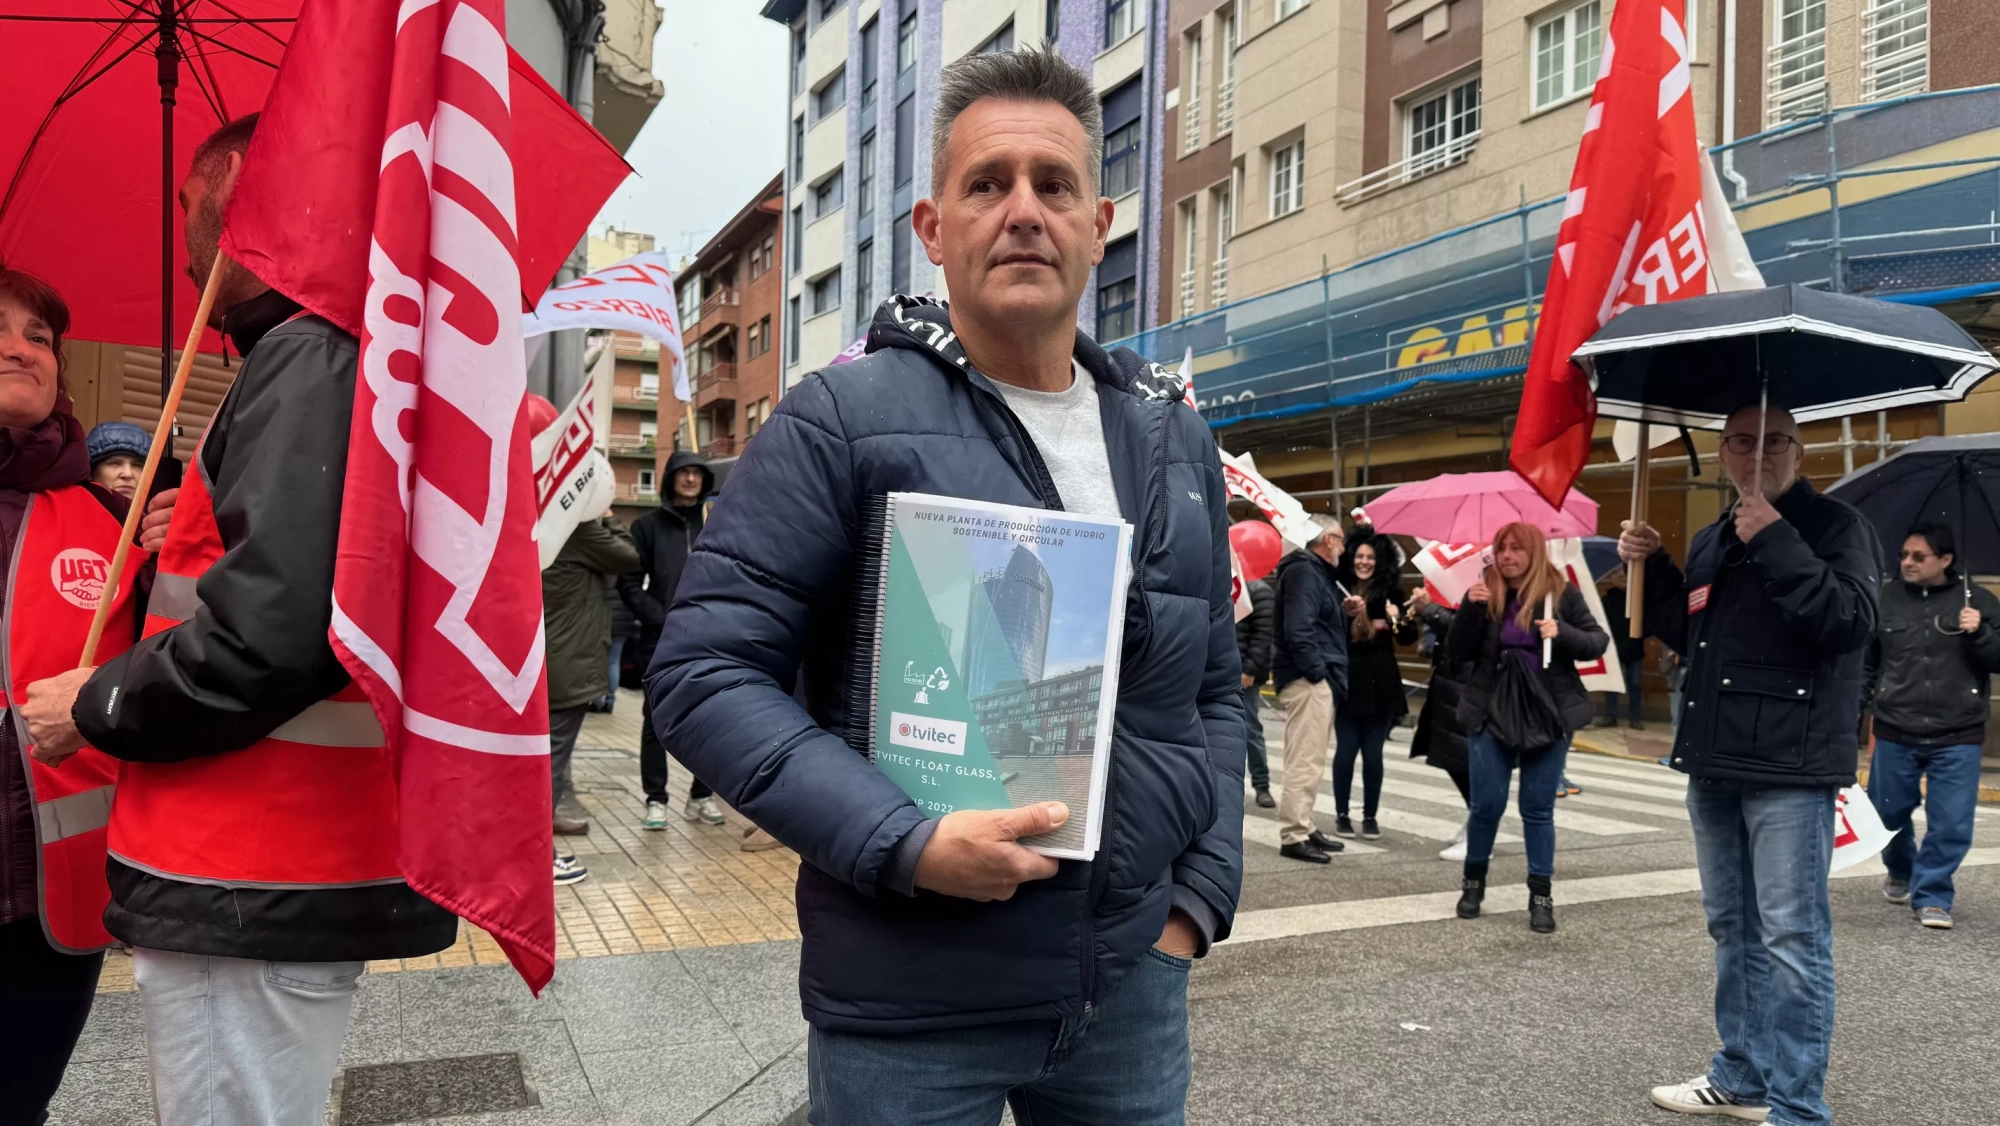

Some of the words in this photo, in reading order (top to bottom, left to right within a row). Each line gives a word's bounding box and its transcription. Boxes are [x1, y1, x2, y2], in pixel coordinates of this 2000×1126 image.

[560, 490, 575, 511] El
[575, 466, 595, 493] Bie
[914, 511, 944, 522] NUEVA
[946, 514, 981, 527] PLANTA
[983, 519, 997, 528] DE
[998, 520, 1057, 535] PRODUCCIÓN
[1059, 527, 1072, 536] DE
[1074, 529, 1105, 540] VIDRIO
[952, 526, 1009, 541] SOSTENIBLE
[1011, 533, 1017, 541] Y
[1018, 534, 1064, 547] CIRCULAR
[60, 559, 107, 583] UGT
[1065, 705, 1089, 714] HOMES
[912, 724, 956, 745] tvitec
[875, 750, 911, 766] TVITEC
[915, 759, 951, 773] FLOAT
[955, 765, 996, 781] GLASS,
[921, 775, 941, 786] S.L.
[927, 800, 954, 813] 2022
